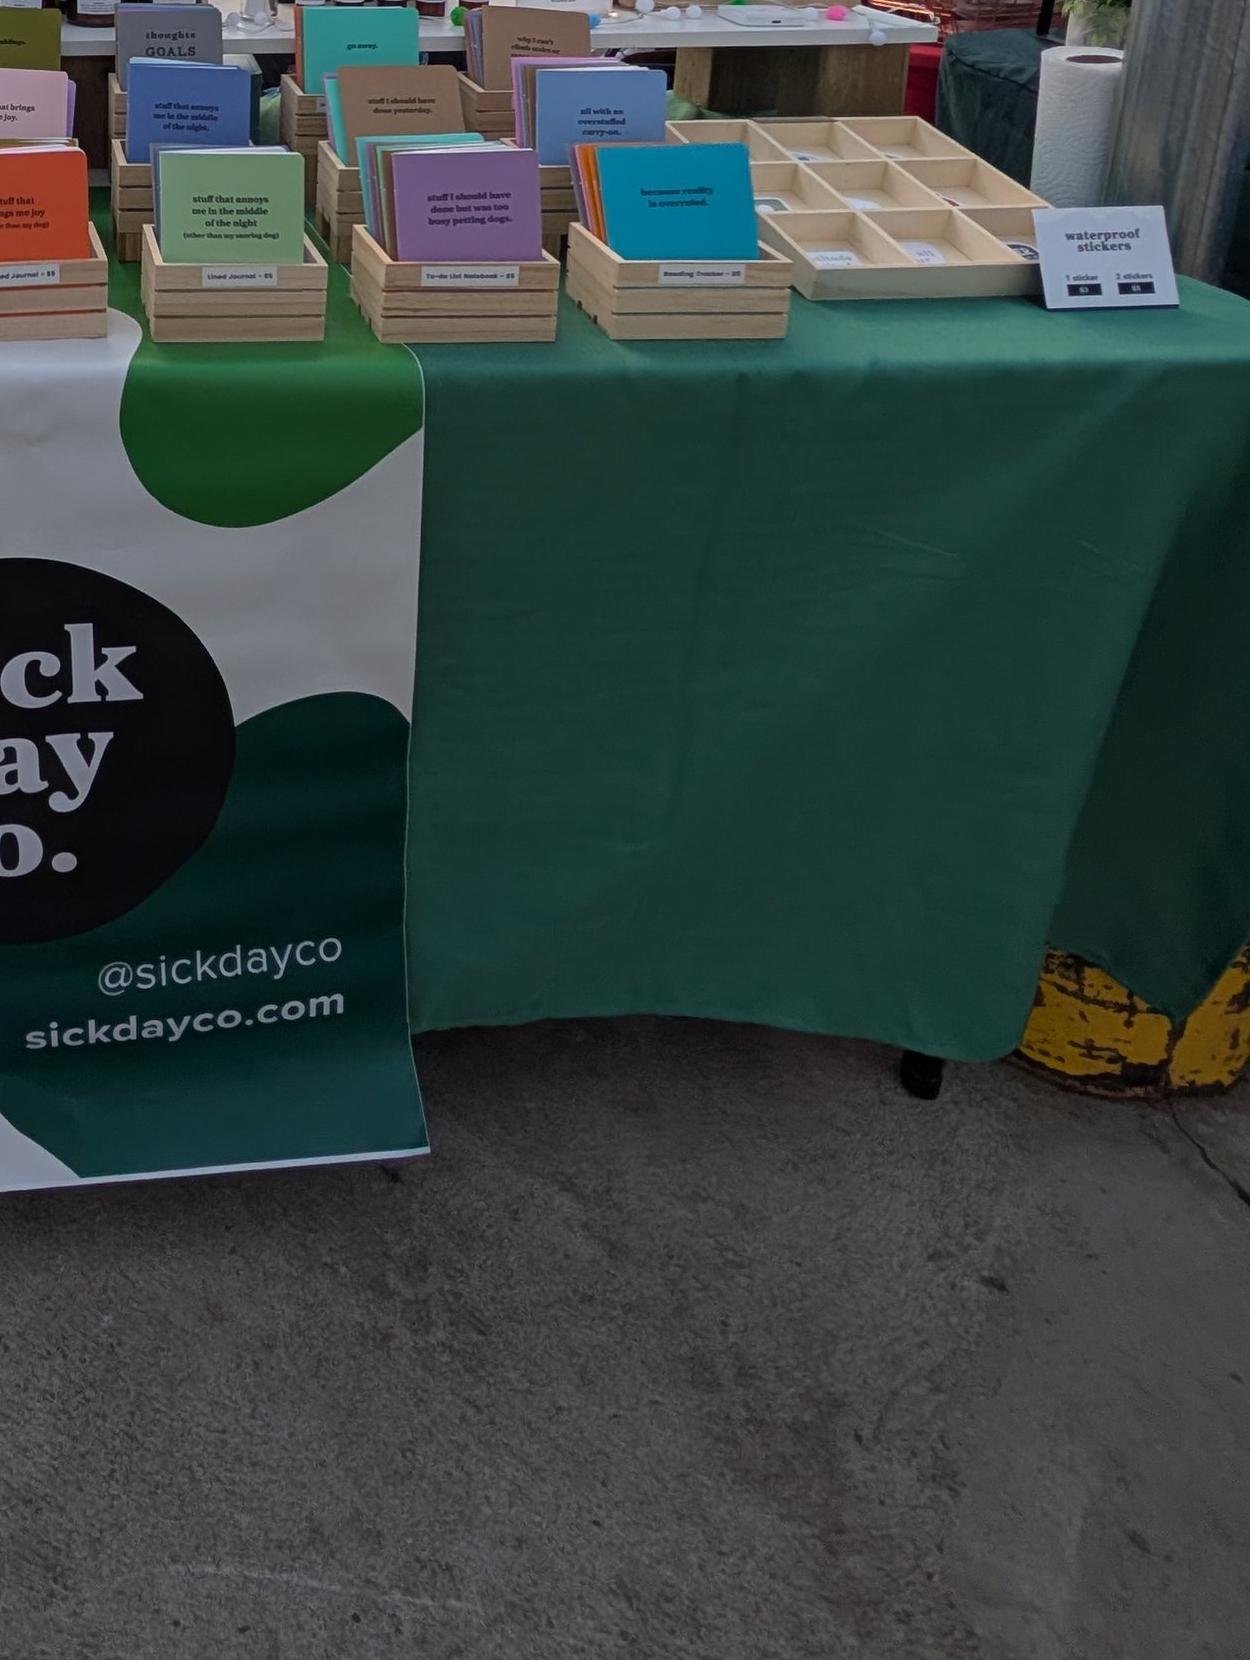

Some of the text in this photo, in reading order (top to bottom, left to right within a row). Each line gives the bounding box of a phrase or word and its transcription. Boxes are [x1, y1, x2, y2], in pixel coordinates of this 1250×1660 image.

[145, 31, 196, 41] thoughts
[145, 47, 196, 57] GOALS
[10, 103, 35, 113] brings
[154, 102, 173, 110] stuff
[190, 104, 219, 112] annoys
[3, 114, 18, 122] joy.
[682, 186, 713, 196] reality
[16, 196, 35, 205] that
[192, 195, 269, 205] stuff that annoys
[31, 208, 46, 218] joy
[208, 207, 217, 215] in
[219, 207, 235, 215] the
[236, 207, 269, 215] middle
[33, 221, 49, 230] dog)
[205, 219, 257, 228] of the night
[428, 215, 513, 226] busy petting dogs.
[183, 232, 205, 240] (other
[235, 232, 262, 240] snoring
[263, 232, 280, 240] dog)
[1065, 228, 1141, 242] waterproof
[1077, 241, 1132, 252] stickers
[97, 937, 343, 996] @sickdayco
[25, 992, 345, 1050] sickdayco.com
